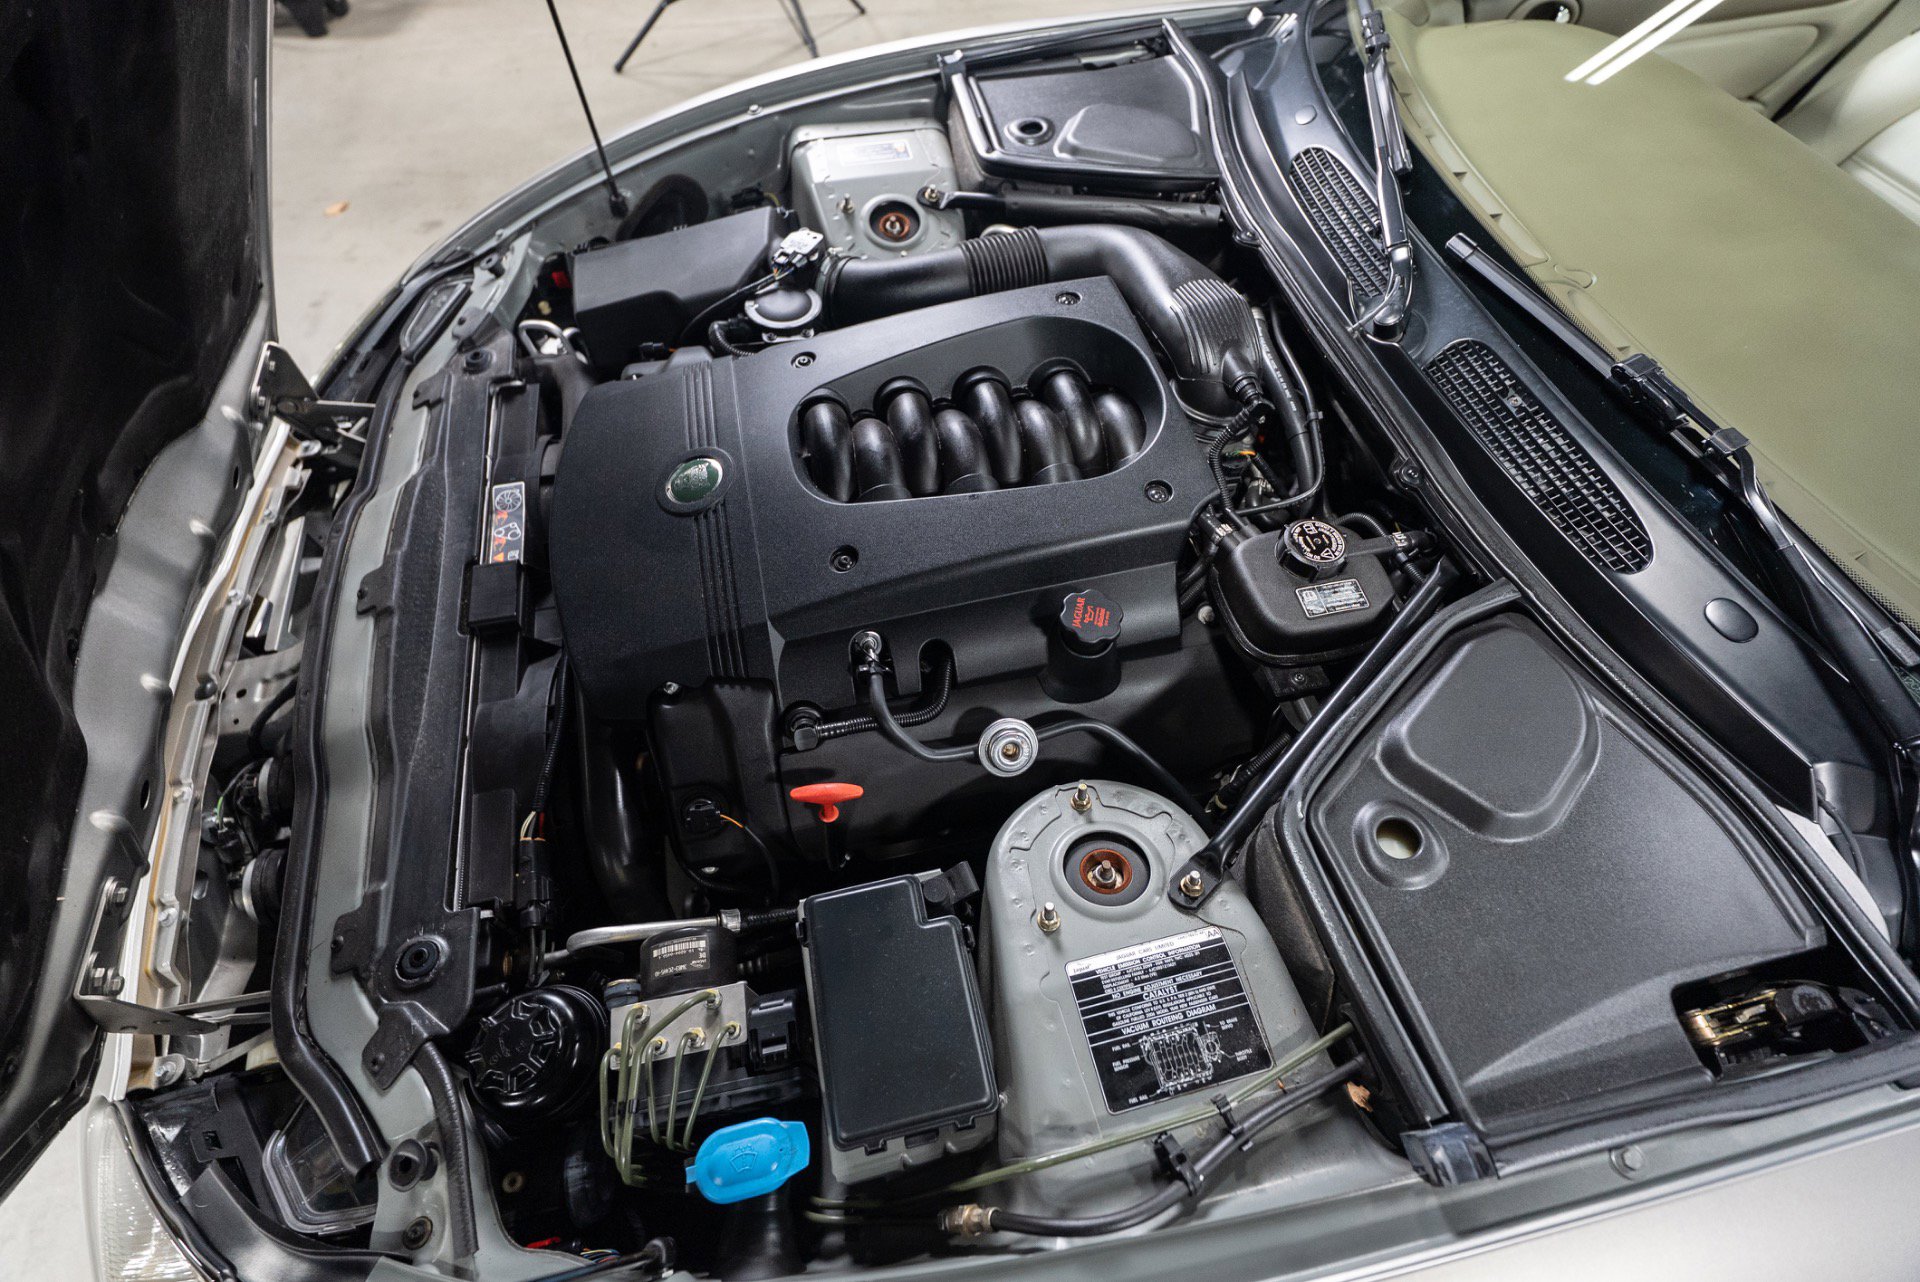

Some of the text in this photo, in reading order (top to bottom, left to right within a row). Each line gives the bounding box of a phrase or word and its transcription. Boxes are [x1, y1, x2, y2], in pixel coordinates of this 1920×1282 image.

[1072, 597, 1086, 628] JAGUAR
[1096, 965, 1115, 974] VEHICLE
[1117, 959, 1141, 969] EMISSION
[1142, 952, 1166, 962] CONTROL
[1167, 944, 1201, 956] INFORMATION
[1123, 987, 1142, 997] ENGINE
[1143, 979, 1174, 991] ADJUSTMENT
[1175, 971, 1203, 982] NECESSARY
[1142, 985, 1179, 1001] CATALYST
[1121, 1004, 1217, 1035] VACUUM ROUTEING DIAGRAM
